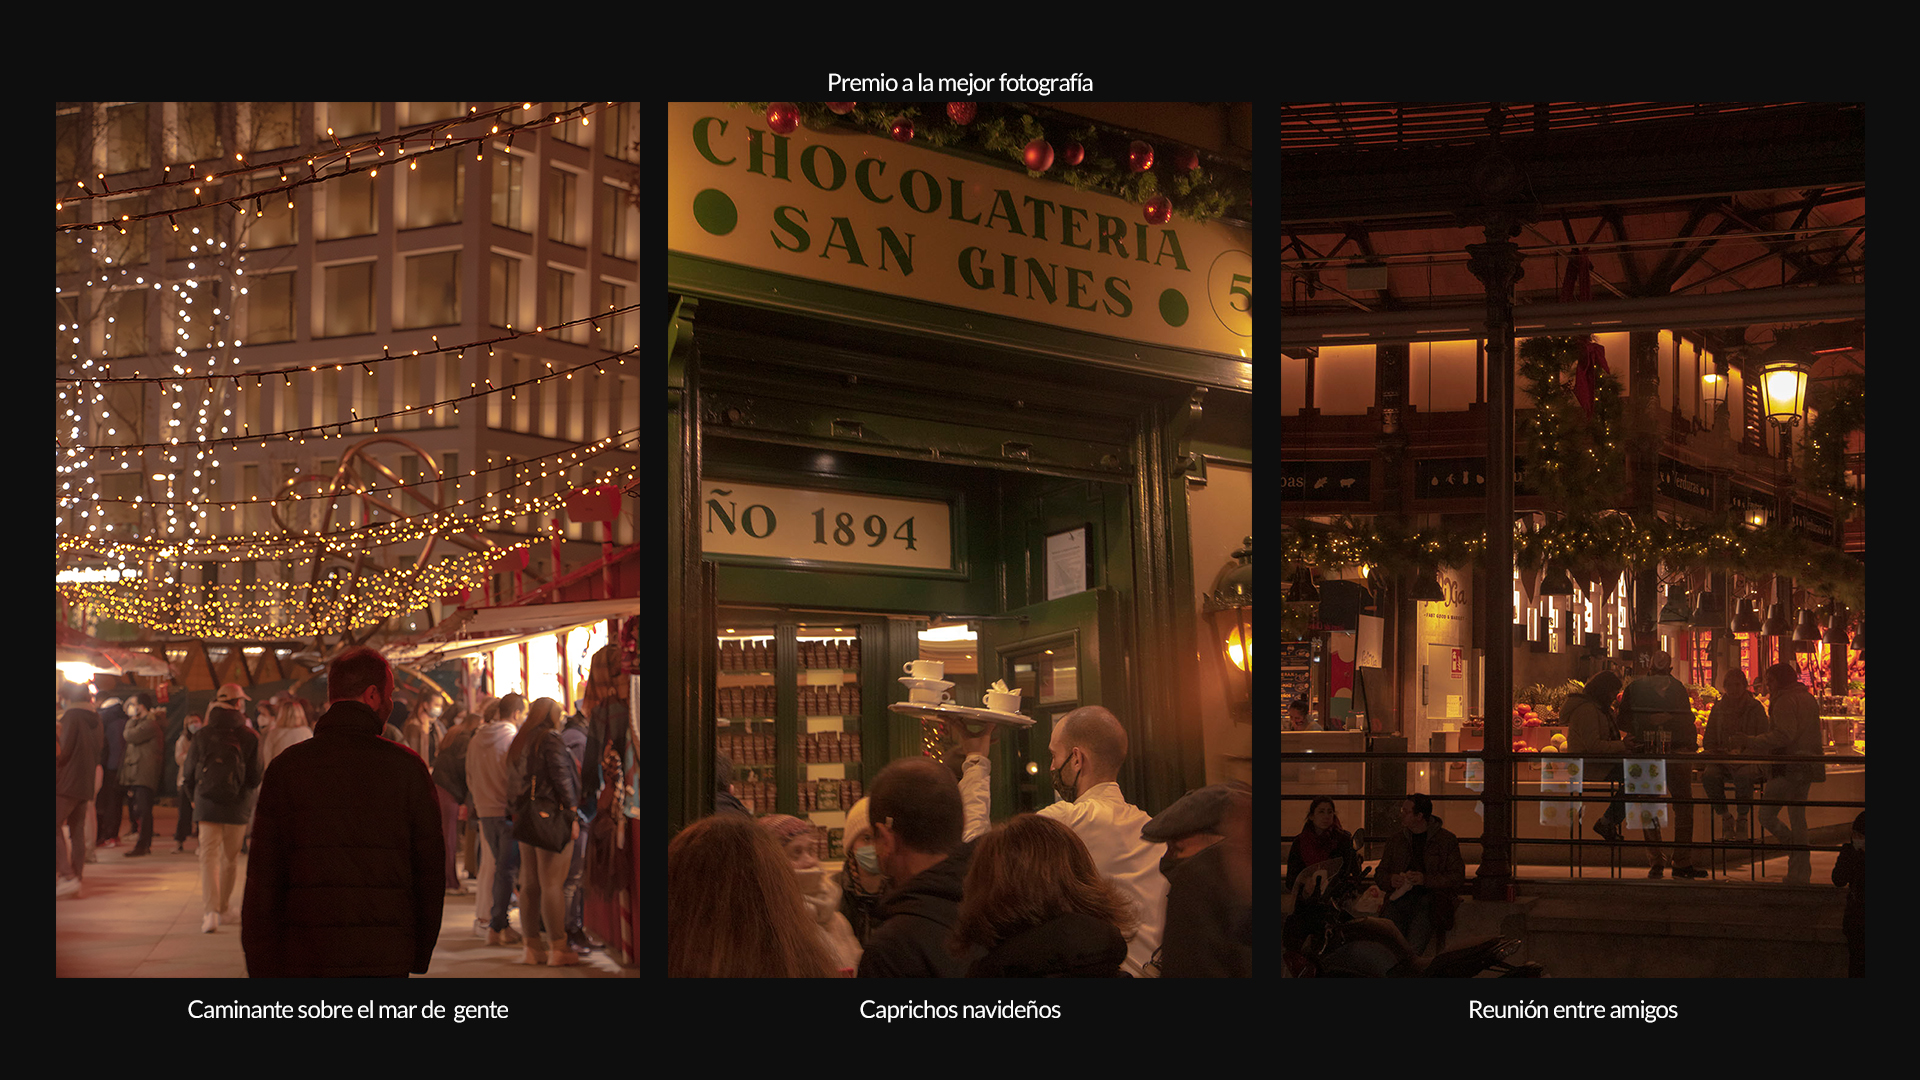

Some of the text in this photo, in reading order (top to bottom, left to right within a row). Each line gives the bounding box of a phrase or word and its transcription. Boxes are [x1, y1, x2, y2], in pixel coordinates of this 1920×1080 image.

[692, 116, 1191, 273] CHOCOLATERIA
[770, 205, 1134, 319] SAN GINES
[706, 489, 917, 551] ÑO 1894
